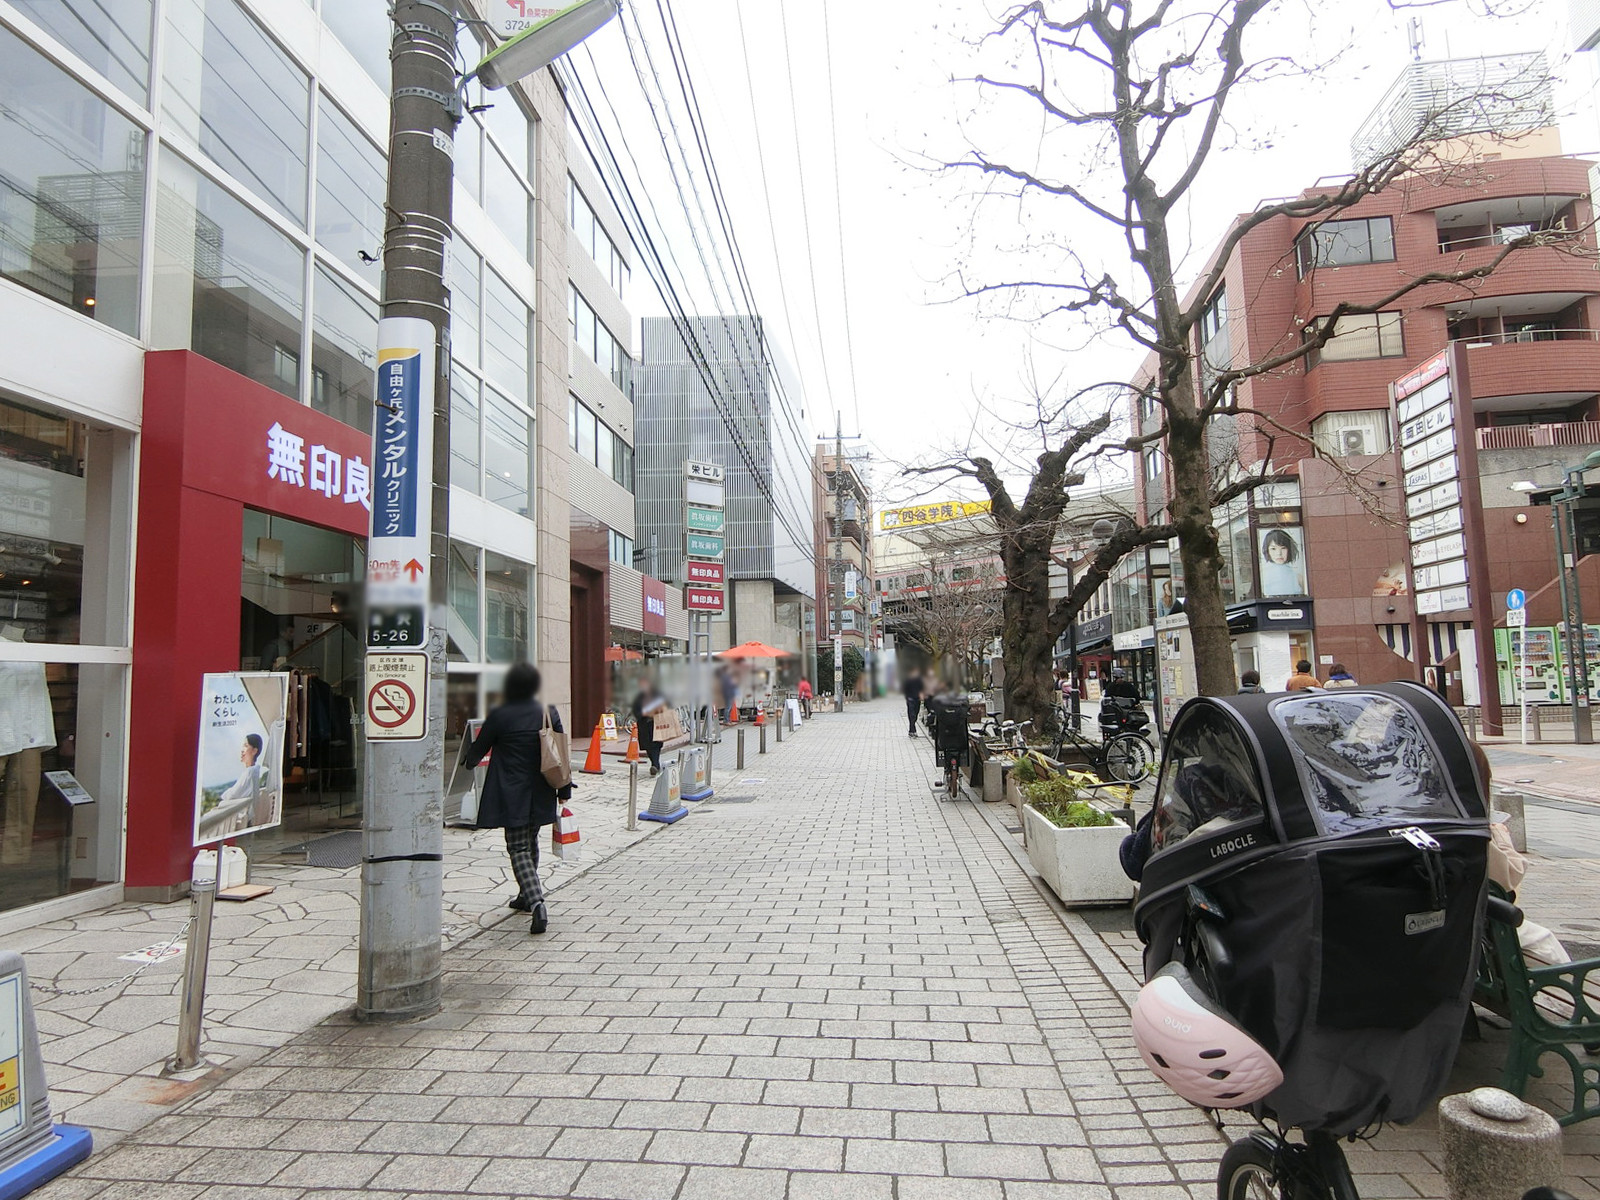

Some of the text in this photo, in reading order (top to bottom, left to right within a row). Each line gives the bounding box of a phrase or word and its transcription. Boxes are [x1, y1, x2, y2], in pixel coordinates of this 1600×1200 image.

[691, 464, 720, 478] 栄ビル
[902, 505, 953, 522] 四谷学院
[1413, 545, 1421, 559] 3F
[691, 567, 720, 578] 無印良品
[691, 594, 720, 605] 無印良品
[307, 624, 320, 633] 2F
[372, 629, 408, 642] 5-26
[369, 664, 416, 672] 路上喫煙禁止
